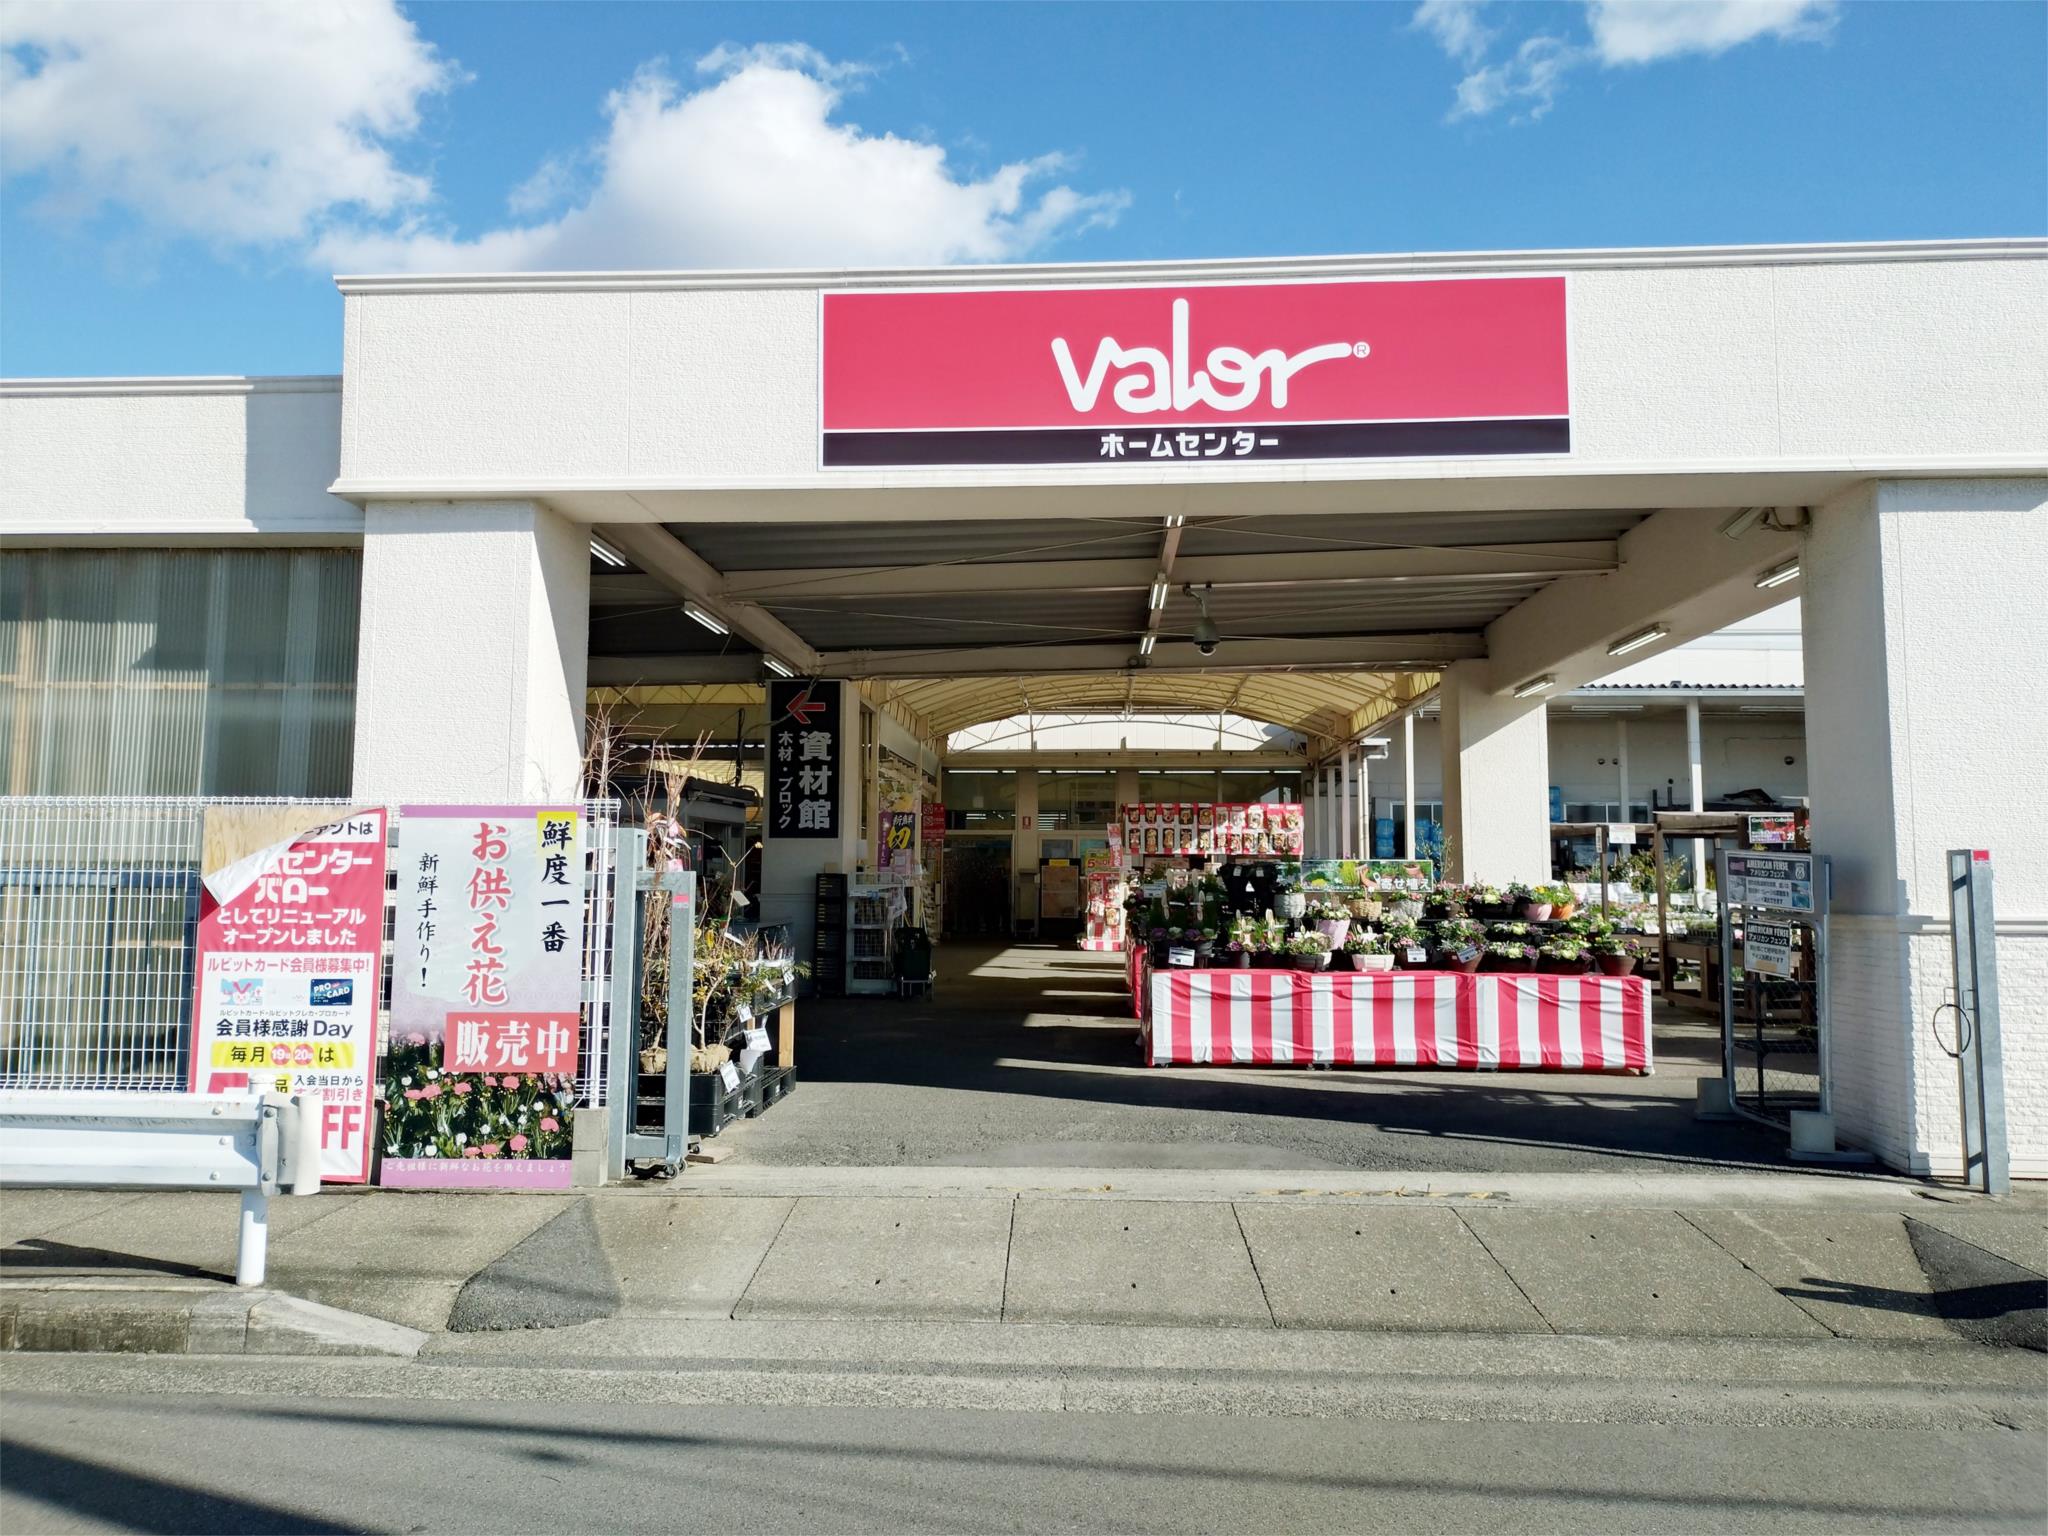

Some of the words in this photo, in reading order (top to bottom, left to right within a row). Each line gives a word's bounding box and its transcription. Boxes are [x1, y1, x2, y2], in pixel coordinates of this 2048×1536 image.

[1101, 431, 1279, 459] ホームセンター
[778, 730, 793, 829] 木材・ブロック
[798, 730, 832, 829] 資材館
[254, 877, 330, 904] バロー
[541, 820, 572, 953] 鮮度一番
[216, 907, 366, 925] としてリニューアル
[416, 853, 440, 987] 新鮮手作り!
[463, 822, 511, 1004] お供え花
[223, 928, 357, 945] オープンしました
[313, 982, 331, 993] PRO
[327, 986, 350, 998] CARD
[455, 1020, 570, 1067] 販売中
[294, 1075, 364, 1087] 入会当日から
